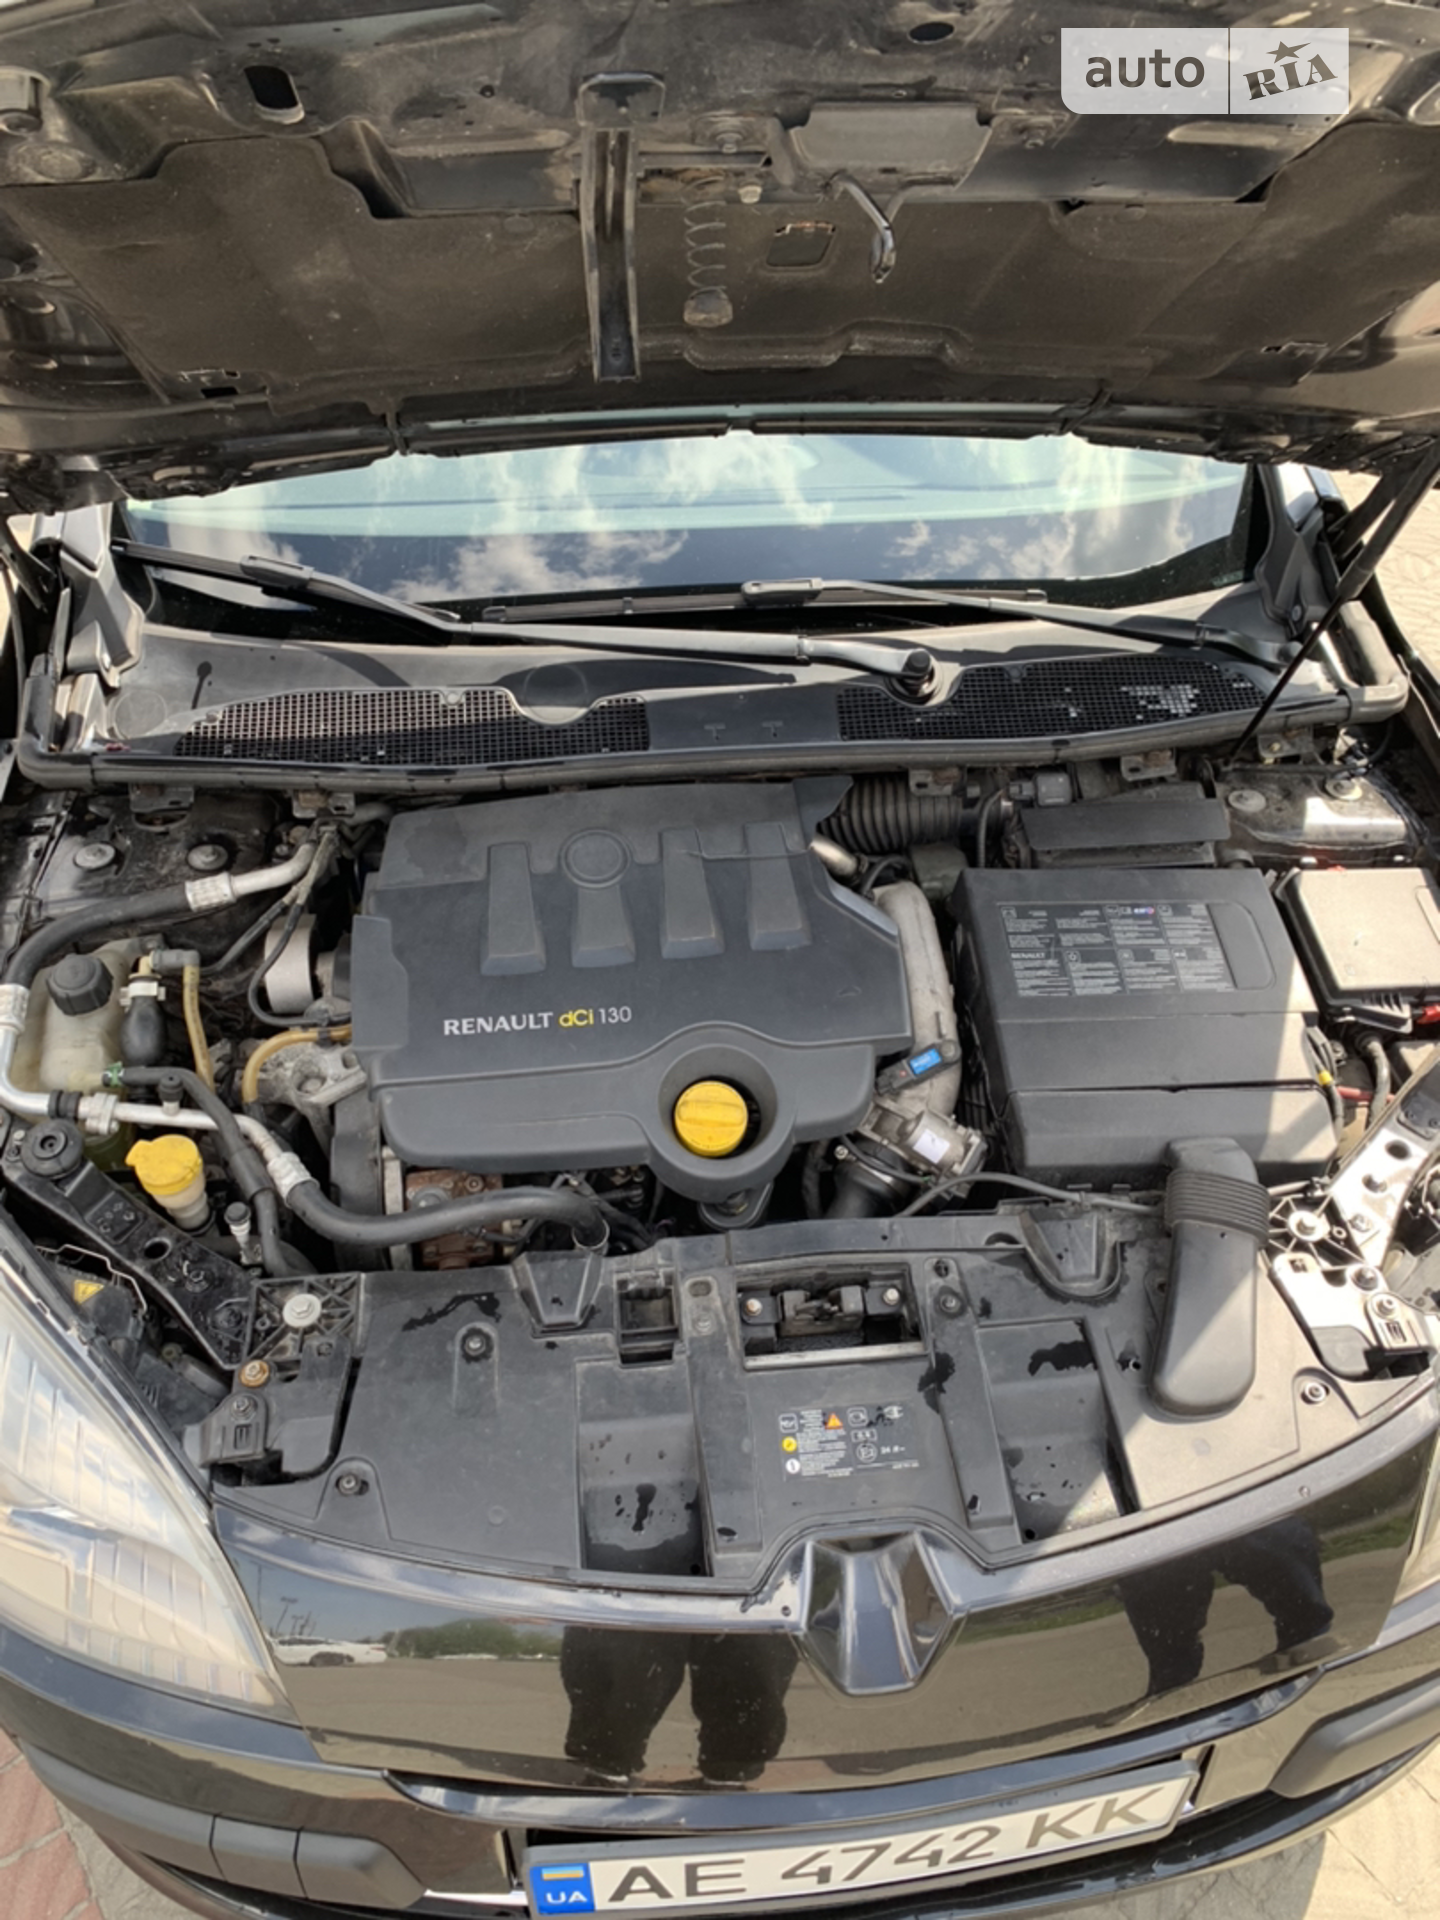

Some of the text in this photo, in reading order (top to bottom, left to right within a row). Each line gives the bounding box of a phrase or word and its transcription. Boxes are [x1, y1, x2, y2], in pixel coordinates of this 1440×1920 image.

[443, 1006, 633, 1036] RENAULT dCi 130
[608, 1786, 1164, 1902] AE 4742 KK
[545, 1891, 588, 1905] UA
